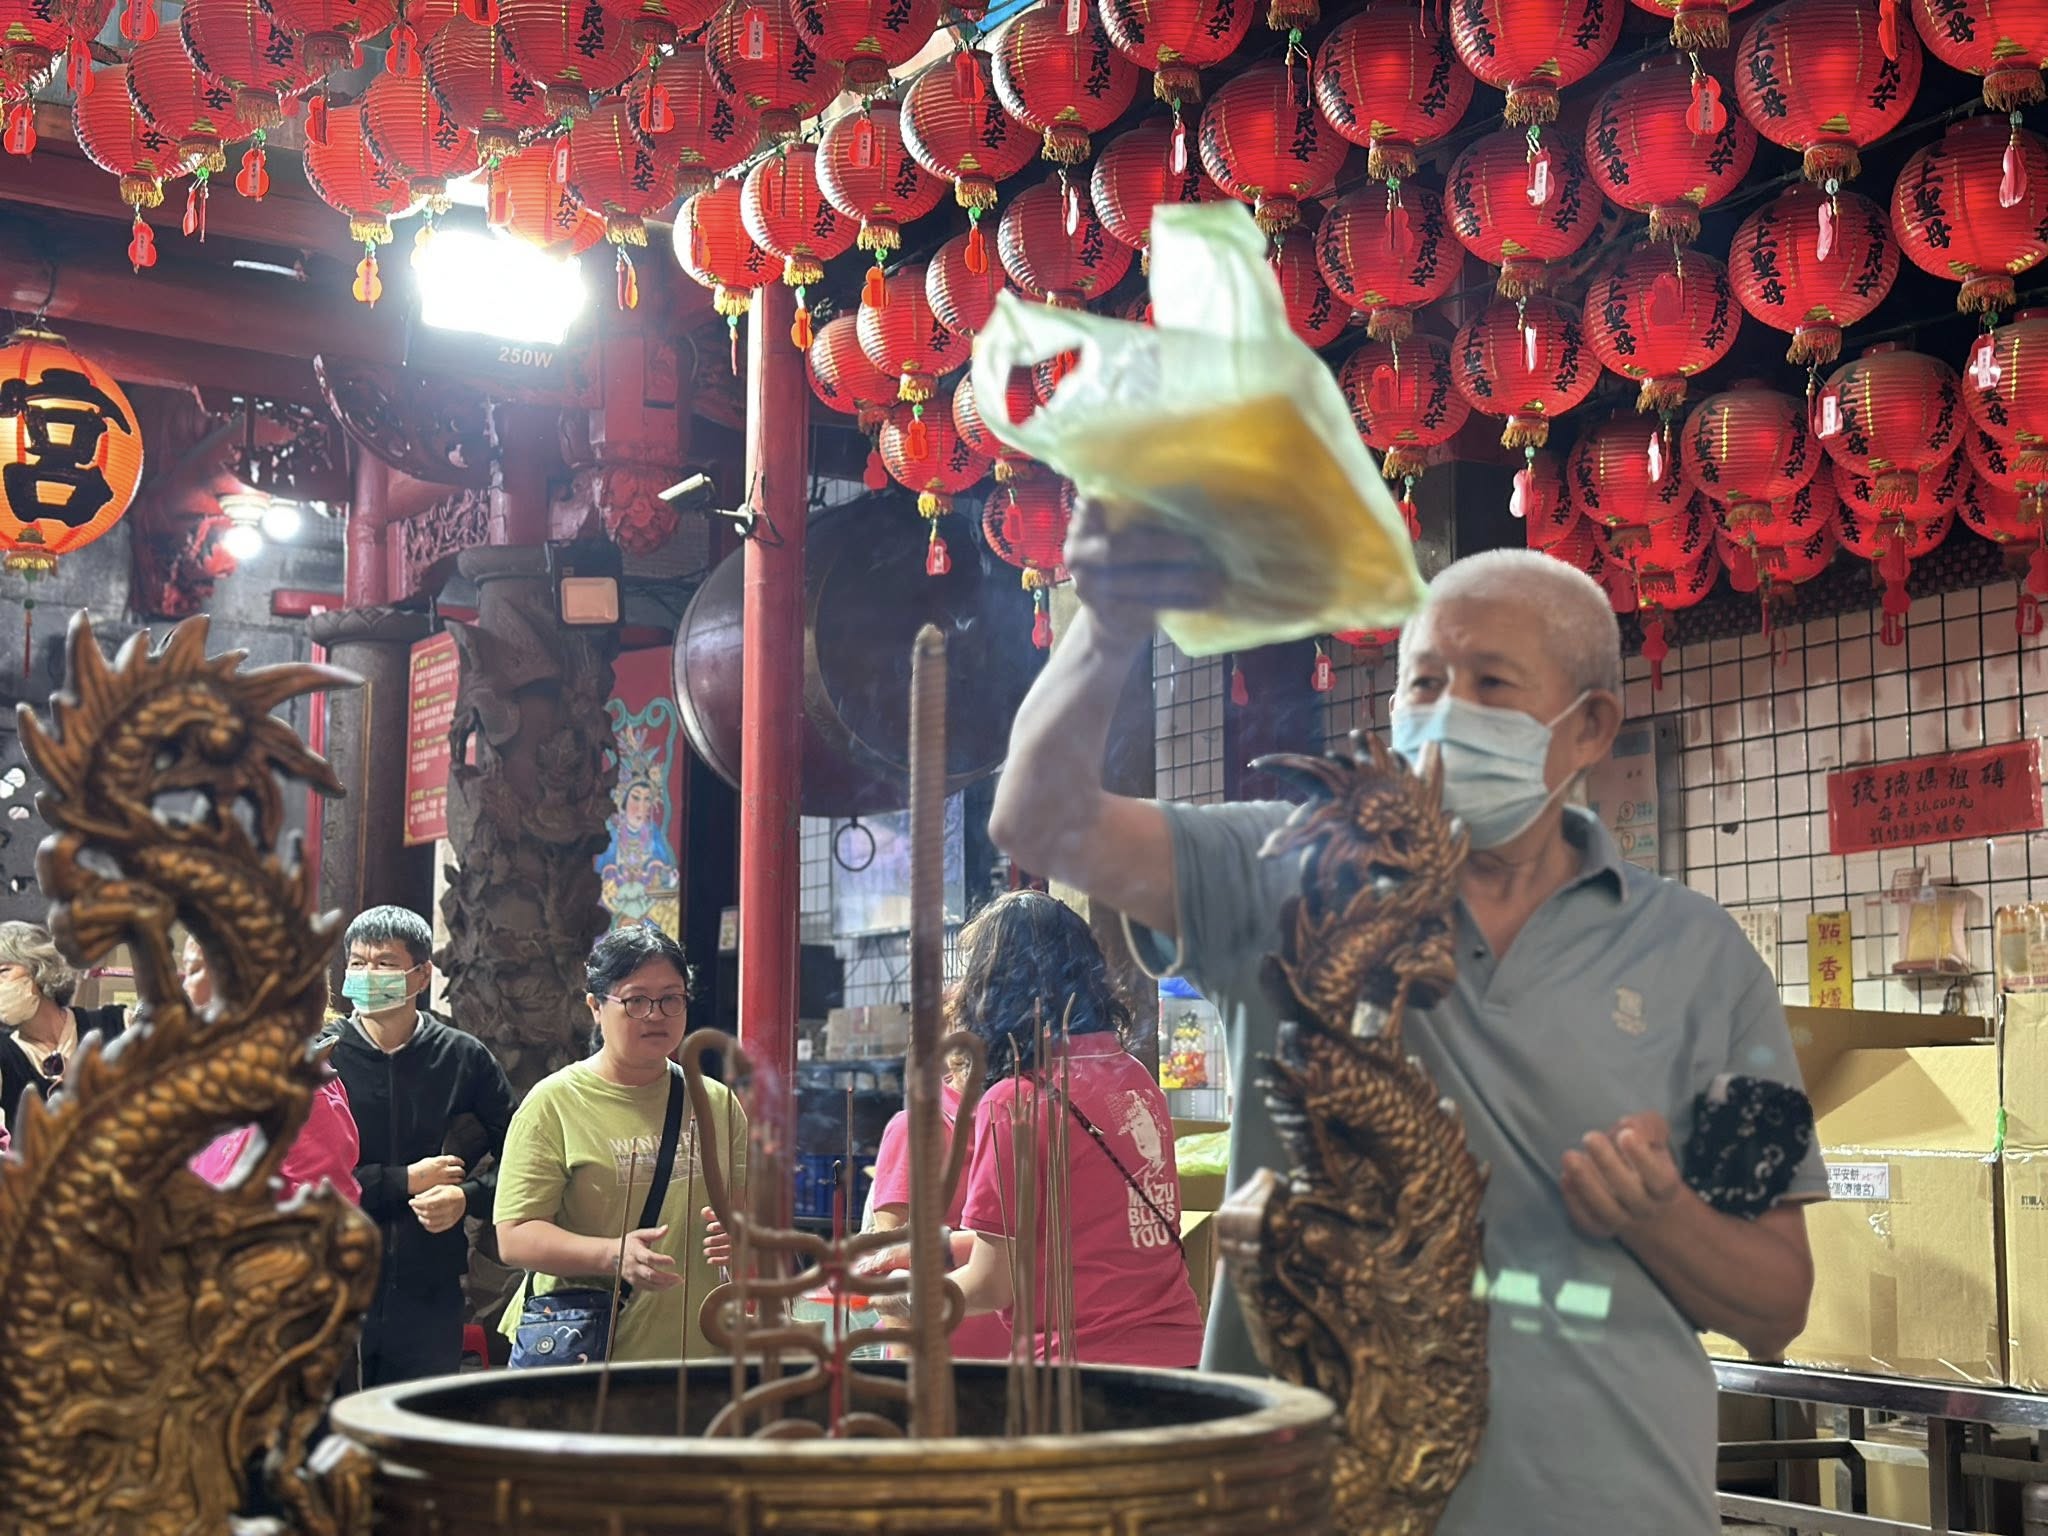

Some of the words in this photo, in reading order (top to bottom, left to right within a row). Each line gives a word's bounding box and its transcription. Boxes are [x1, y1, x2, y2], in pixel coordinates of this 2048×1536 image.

[498, 345, 553, 369] 250W
[0, 367, 132, 528] 宮
[1129, 1223, 1171, 1249] YOU
